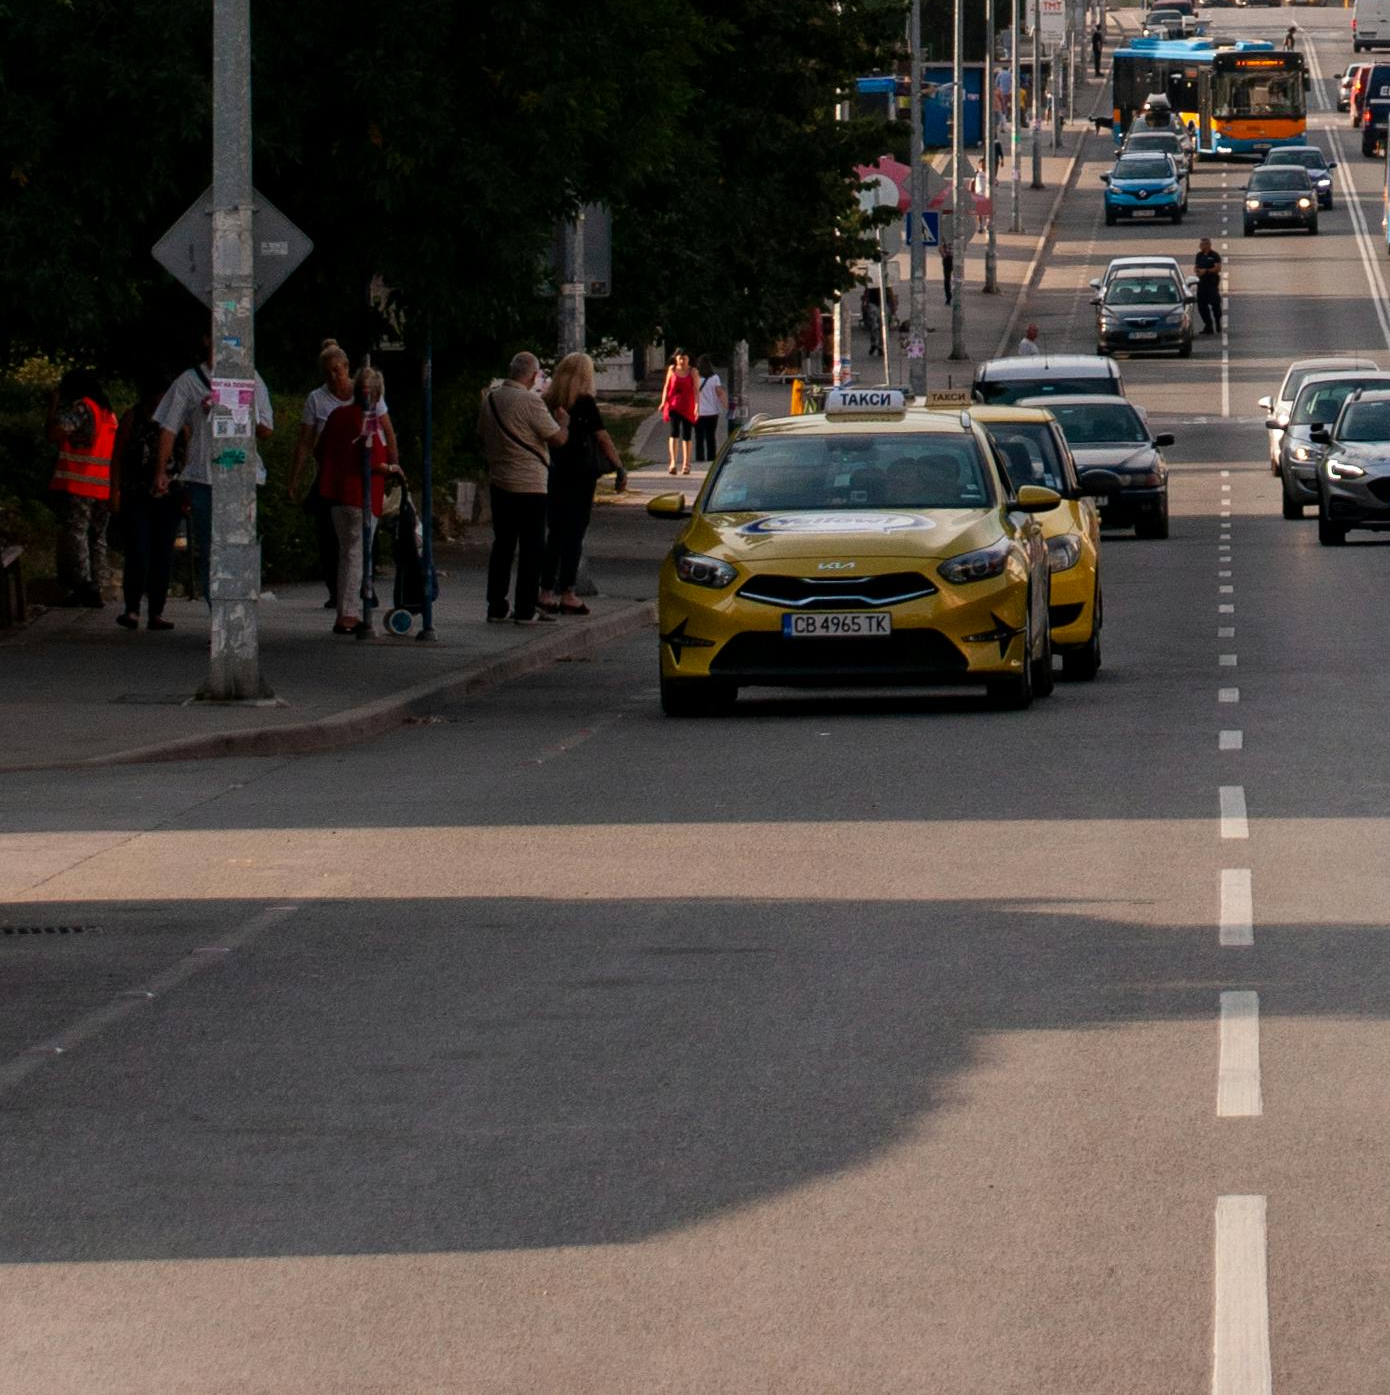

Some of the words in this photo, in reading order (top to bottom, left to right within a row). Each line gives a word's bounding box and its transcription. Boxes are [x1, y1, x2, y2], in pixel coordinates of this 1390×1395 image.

[840, 393, 891, 406] ТАКСИ
[932, 393, 966, 401] ТАКСИ
[794, 616, 816, 633] CB
[820, 616, 862, 633] 4965
[865, 615, 886, 633] TK
